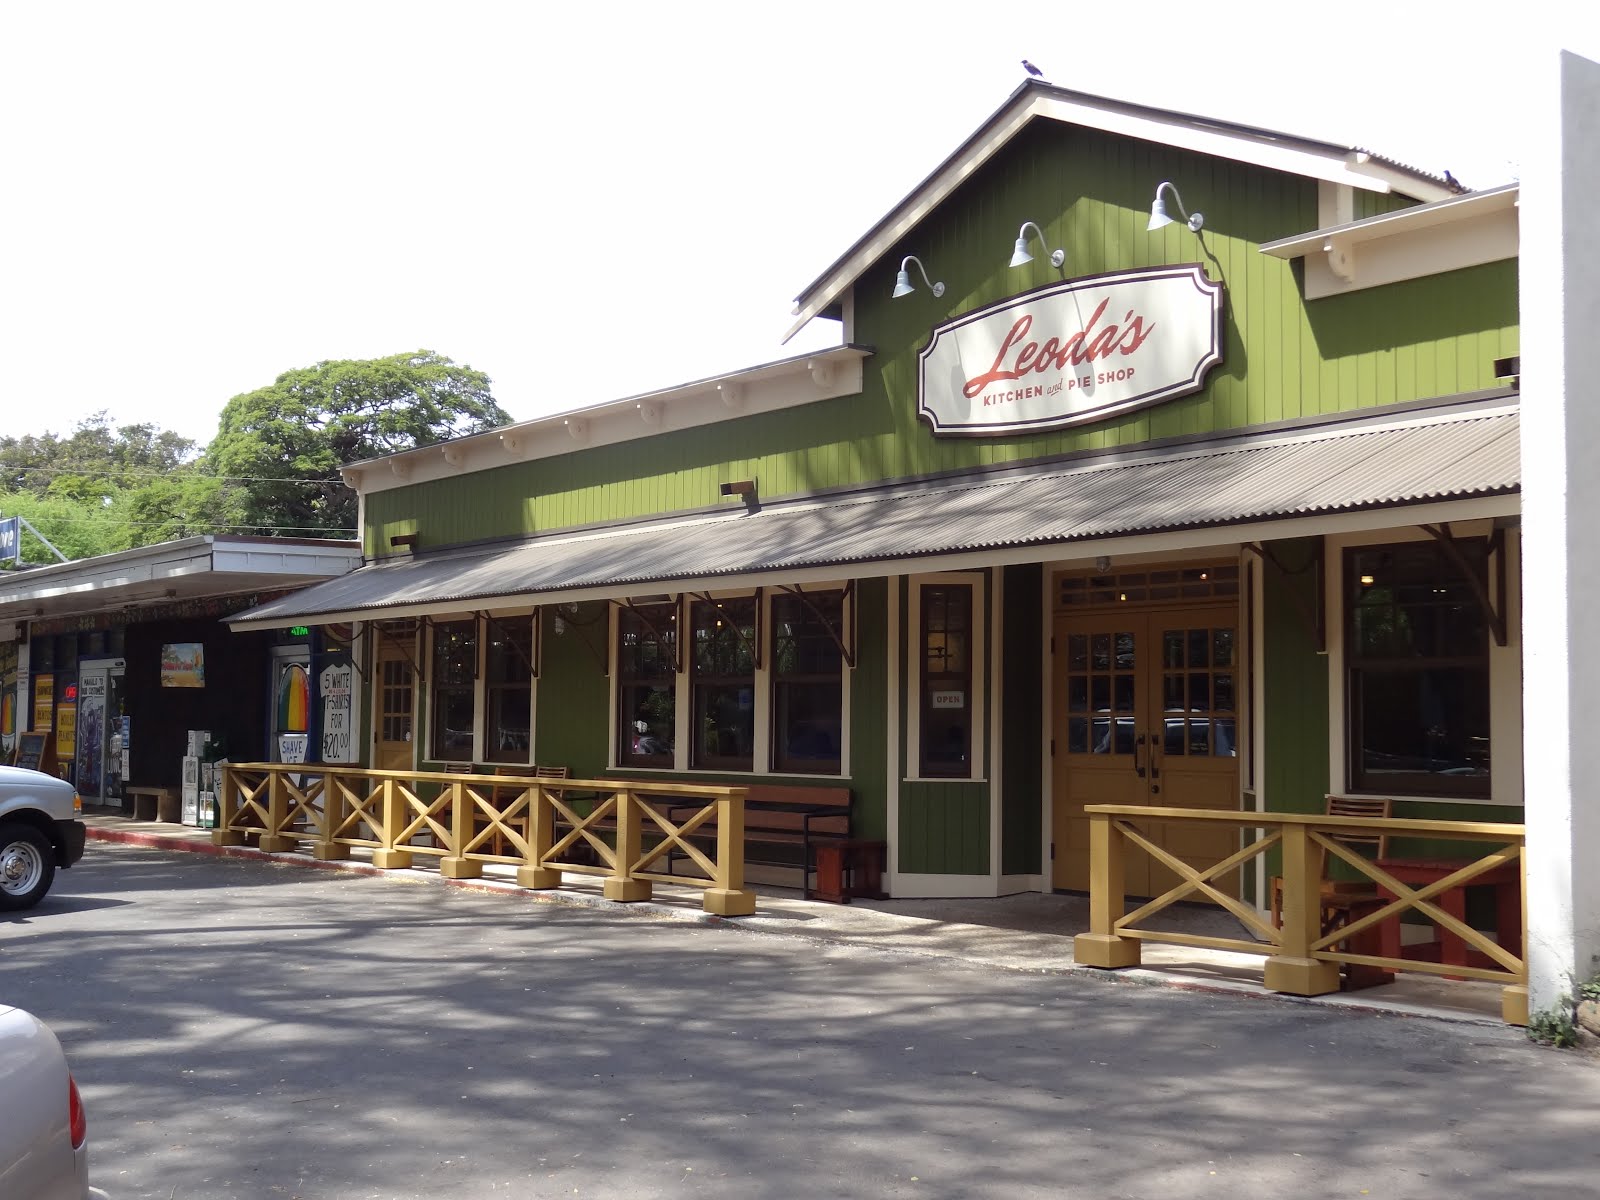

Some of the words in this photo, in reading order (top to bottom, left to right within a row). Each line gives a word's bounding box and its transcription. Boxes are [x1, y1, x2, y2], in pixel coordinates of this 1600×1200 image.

[963, 296, 1156, 399] Leoda's
[983, 384, 1043, 407] KITCHEN
[1046, 378, 1064, 396] and
[1068, 376, 1091, 391] PIE
[1097, 367, 1136, 385] SHOP
[290, 626, 309, 636] ATM
[325, 673, 330, 690] 5
[331, 672, 350, 689] WHITE
[325, 694, 349, 710] T-SHIRTS
[936, 695, 960, 704] OPEN
[330, 713, 343, 729] FOR
[282, 740, 303, 754] SHAVE
